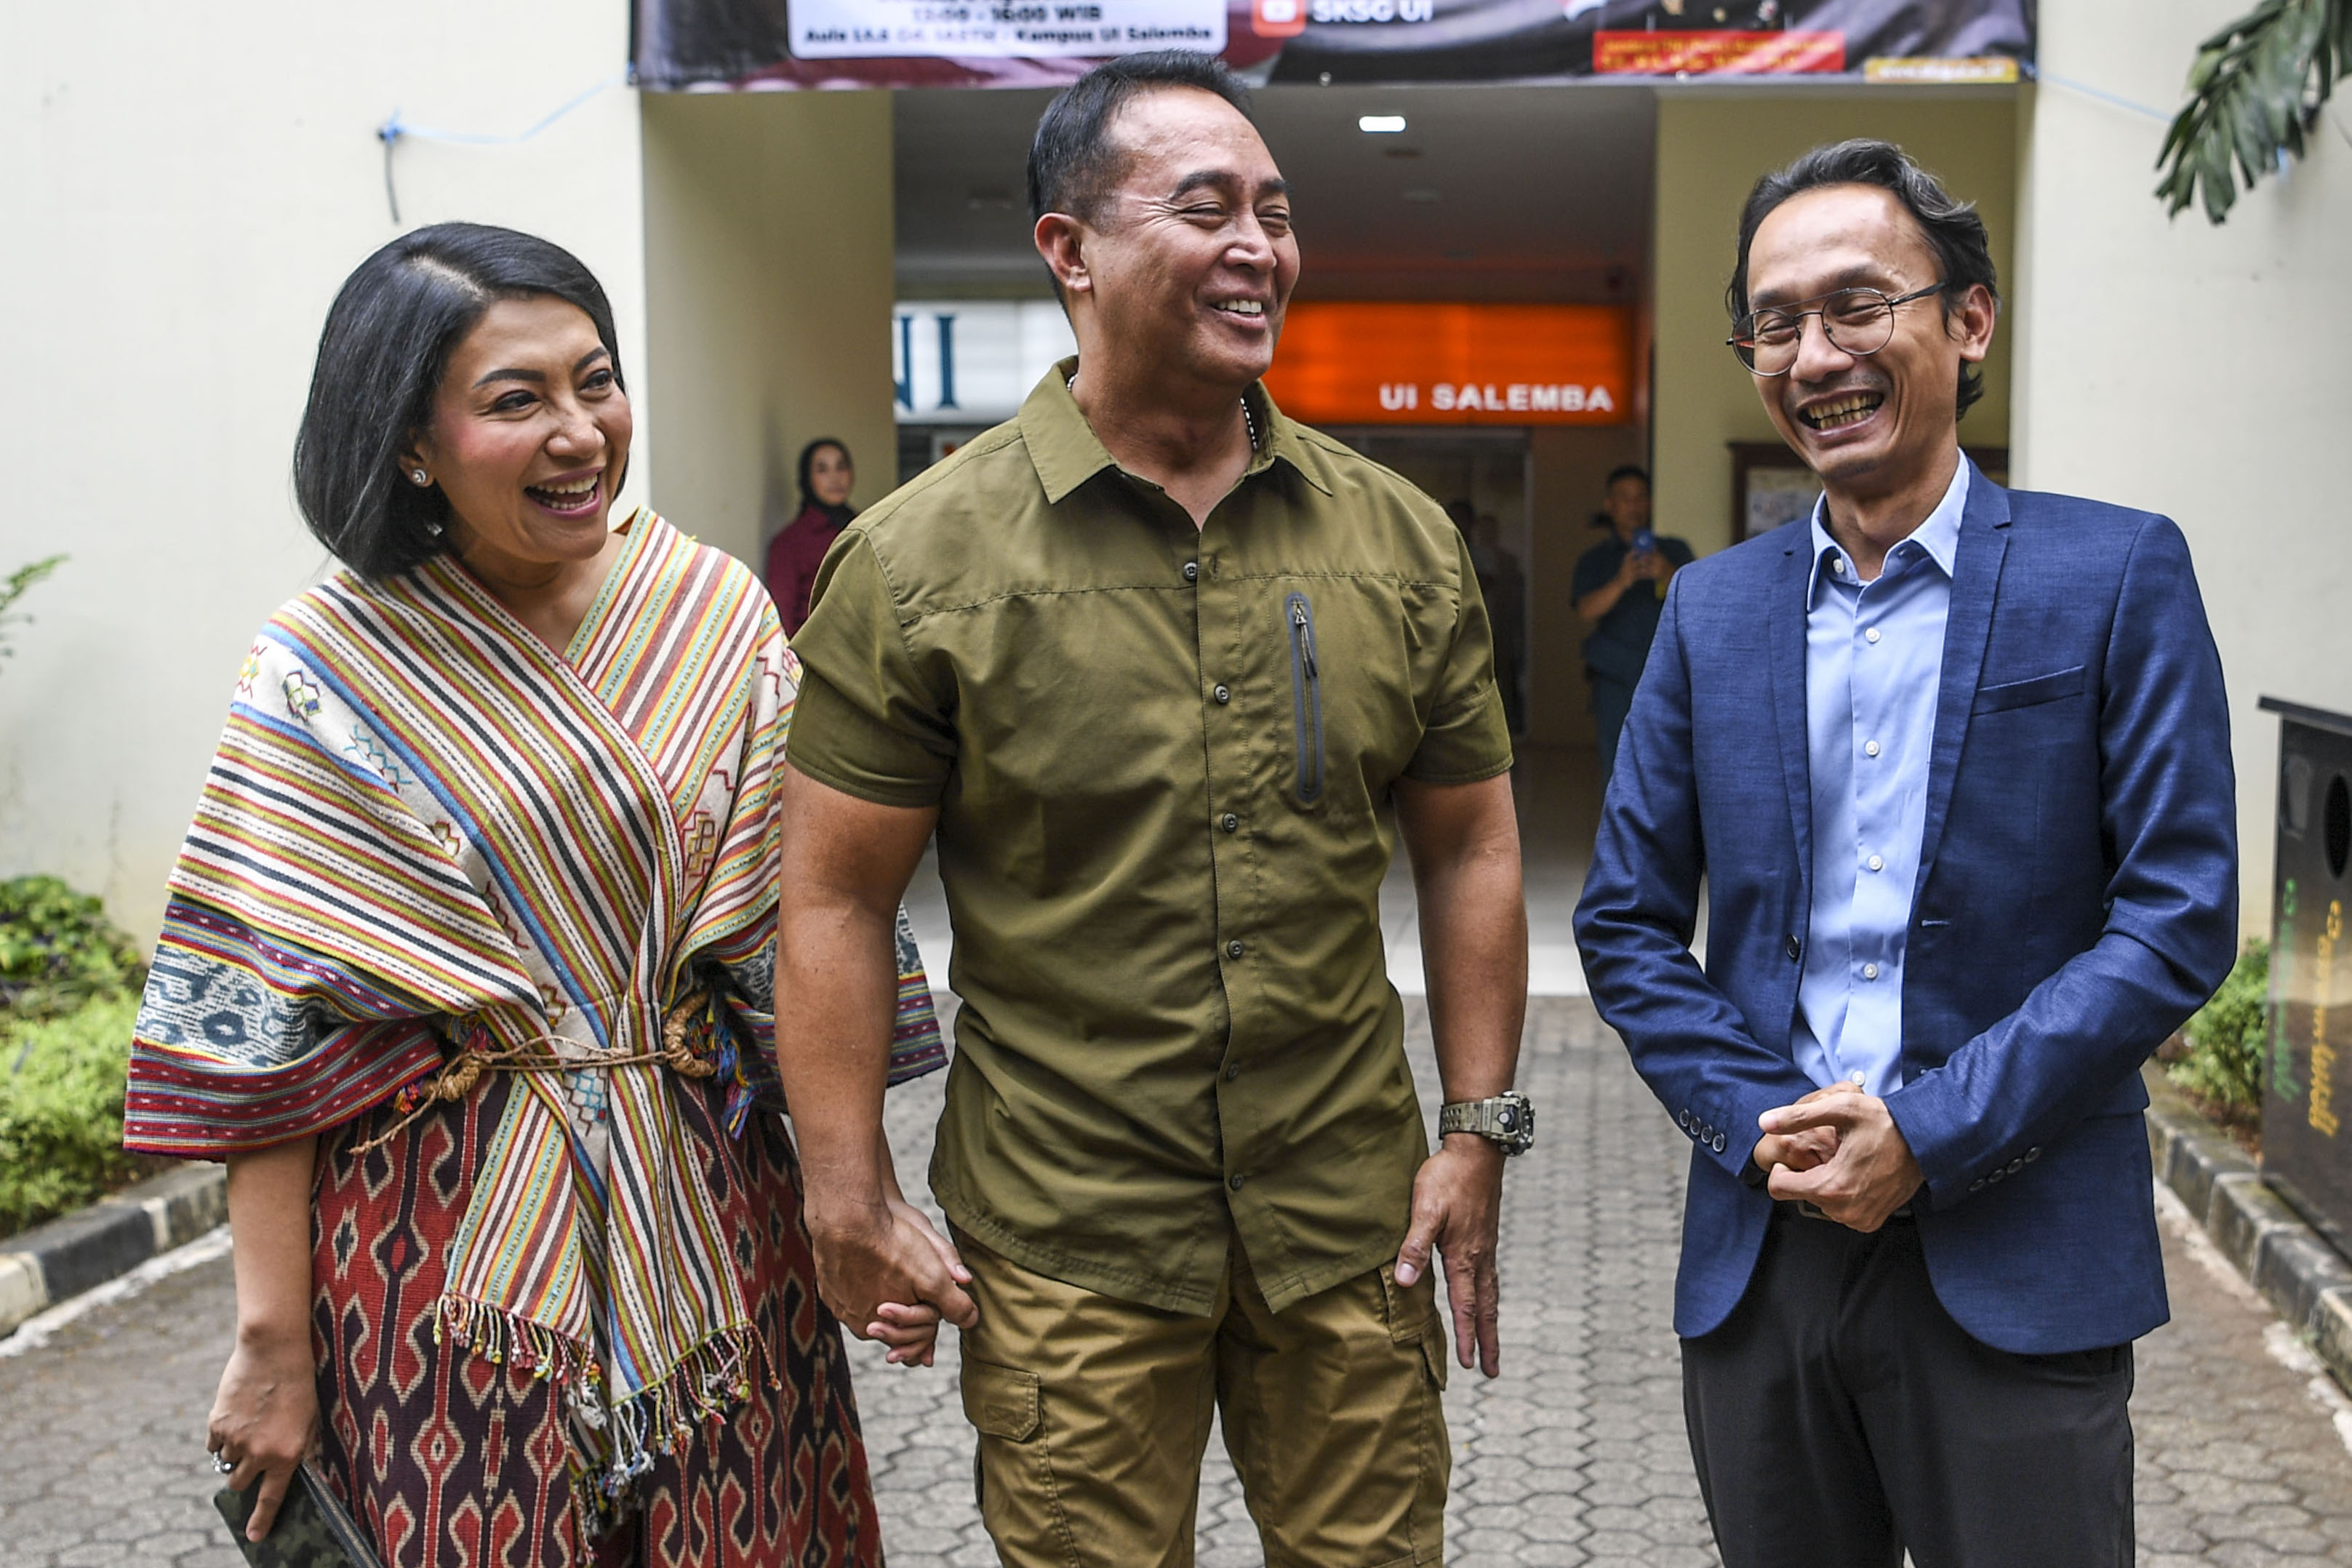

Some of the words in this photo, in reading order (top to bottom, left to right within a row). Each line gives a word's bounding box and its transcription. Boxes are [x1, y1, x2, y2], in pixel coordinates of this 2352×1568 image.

[1055, 6, 1101, 21] WIB
[1399, 0, 1433, 22] UI
[1015, 28, 1094, 44] Kampus
[1127, 25, 1213, 40] Salemba
[1380, 383, 1417, 409] UI
[1431, 384, 1614, 412] SALEMBA
